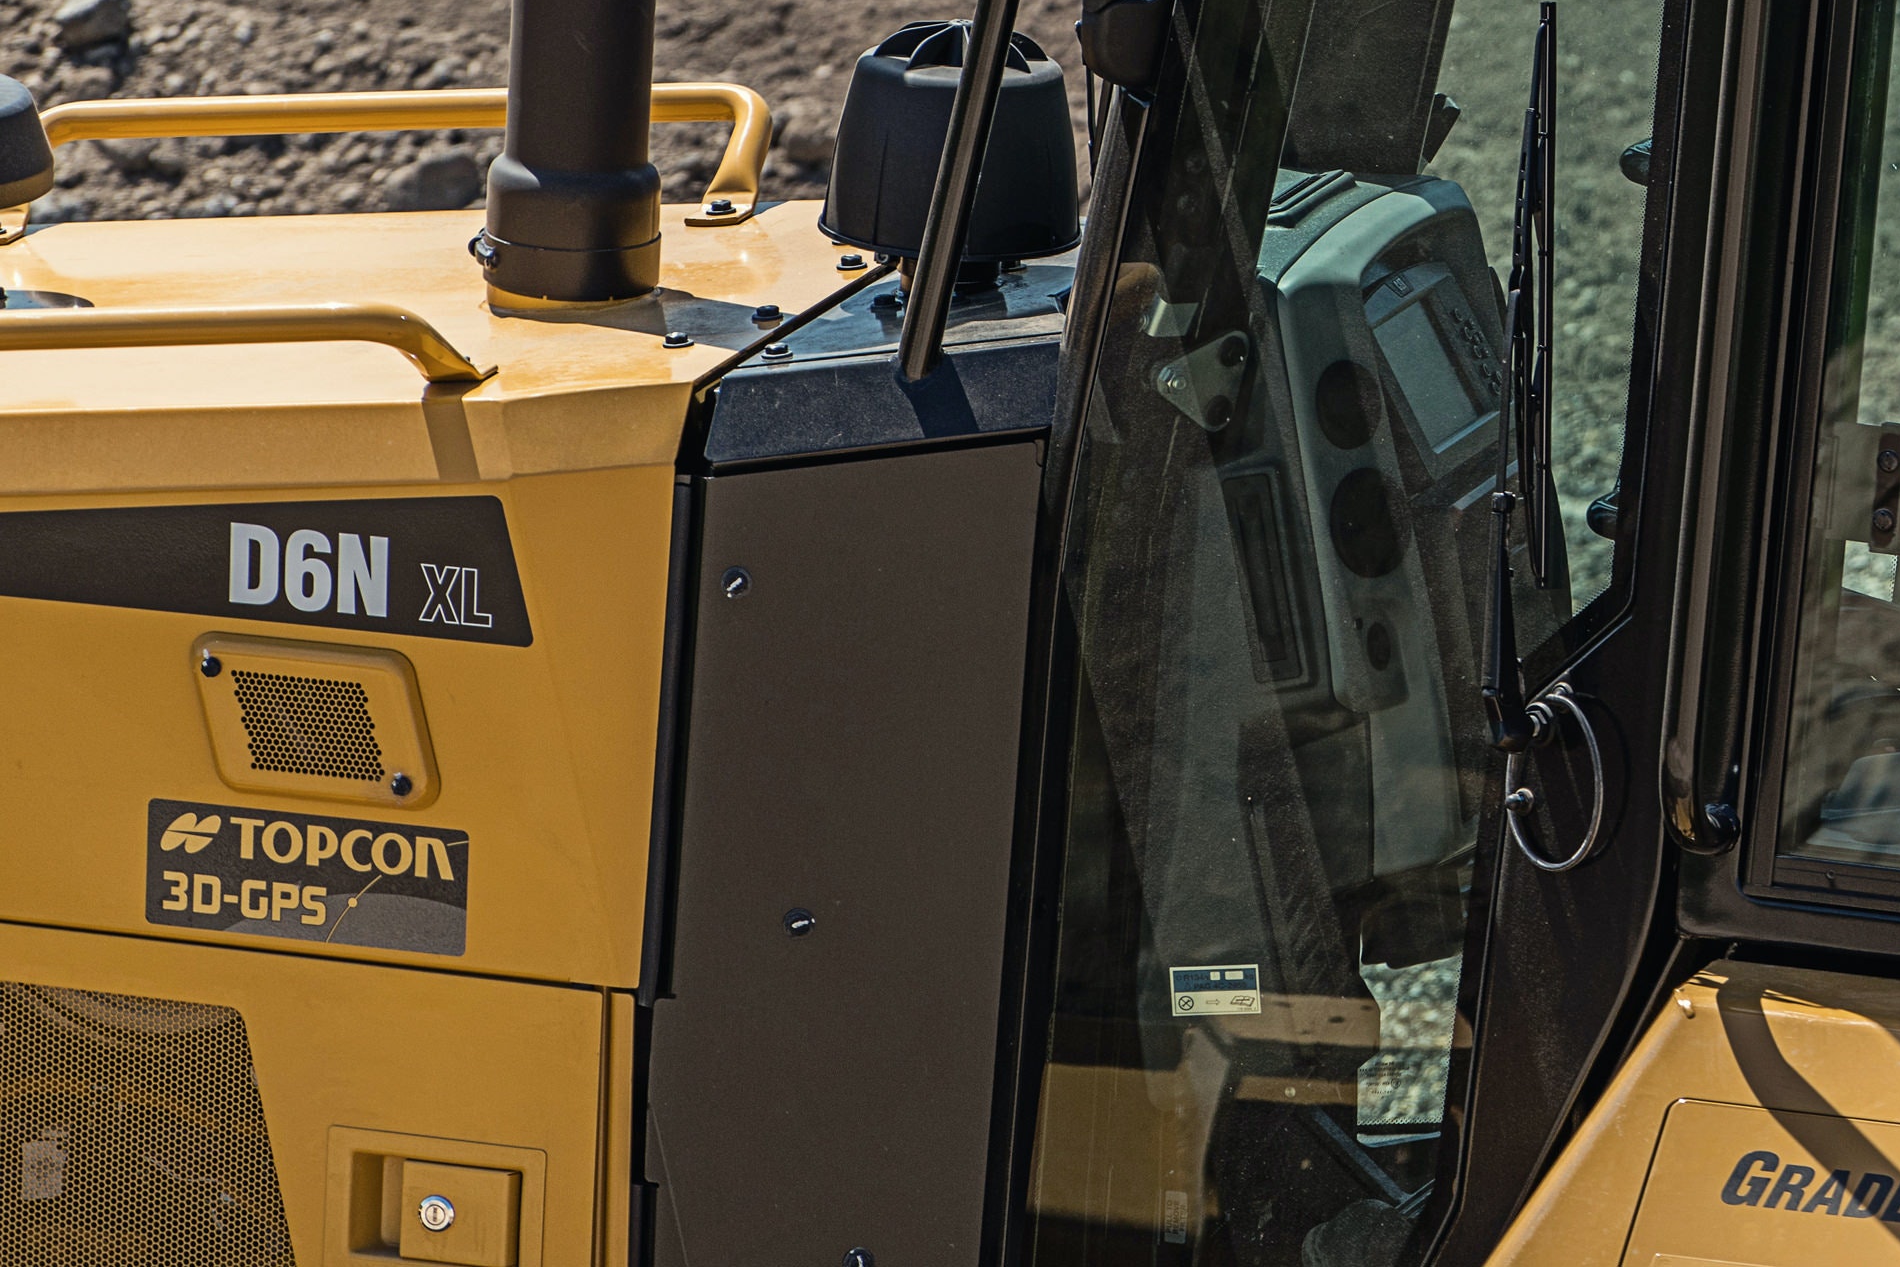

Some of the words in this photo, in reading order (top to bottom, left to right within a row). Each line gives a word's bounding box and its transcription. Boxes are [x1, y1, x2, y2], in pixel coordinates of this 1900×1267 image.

[228, 521, 389, 618] D6N
[418, 563, 493, 628] XL
[229, 815, 454, 881] TOPCON
[161, 870, 328, 926] 3D-GPS
